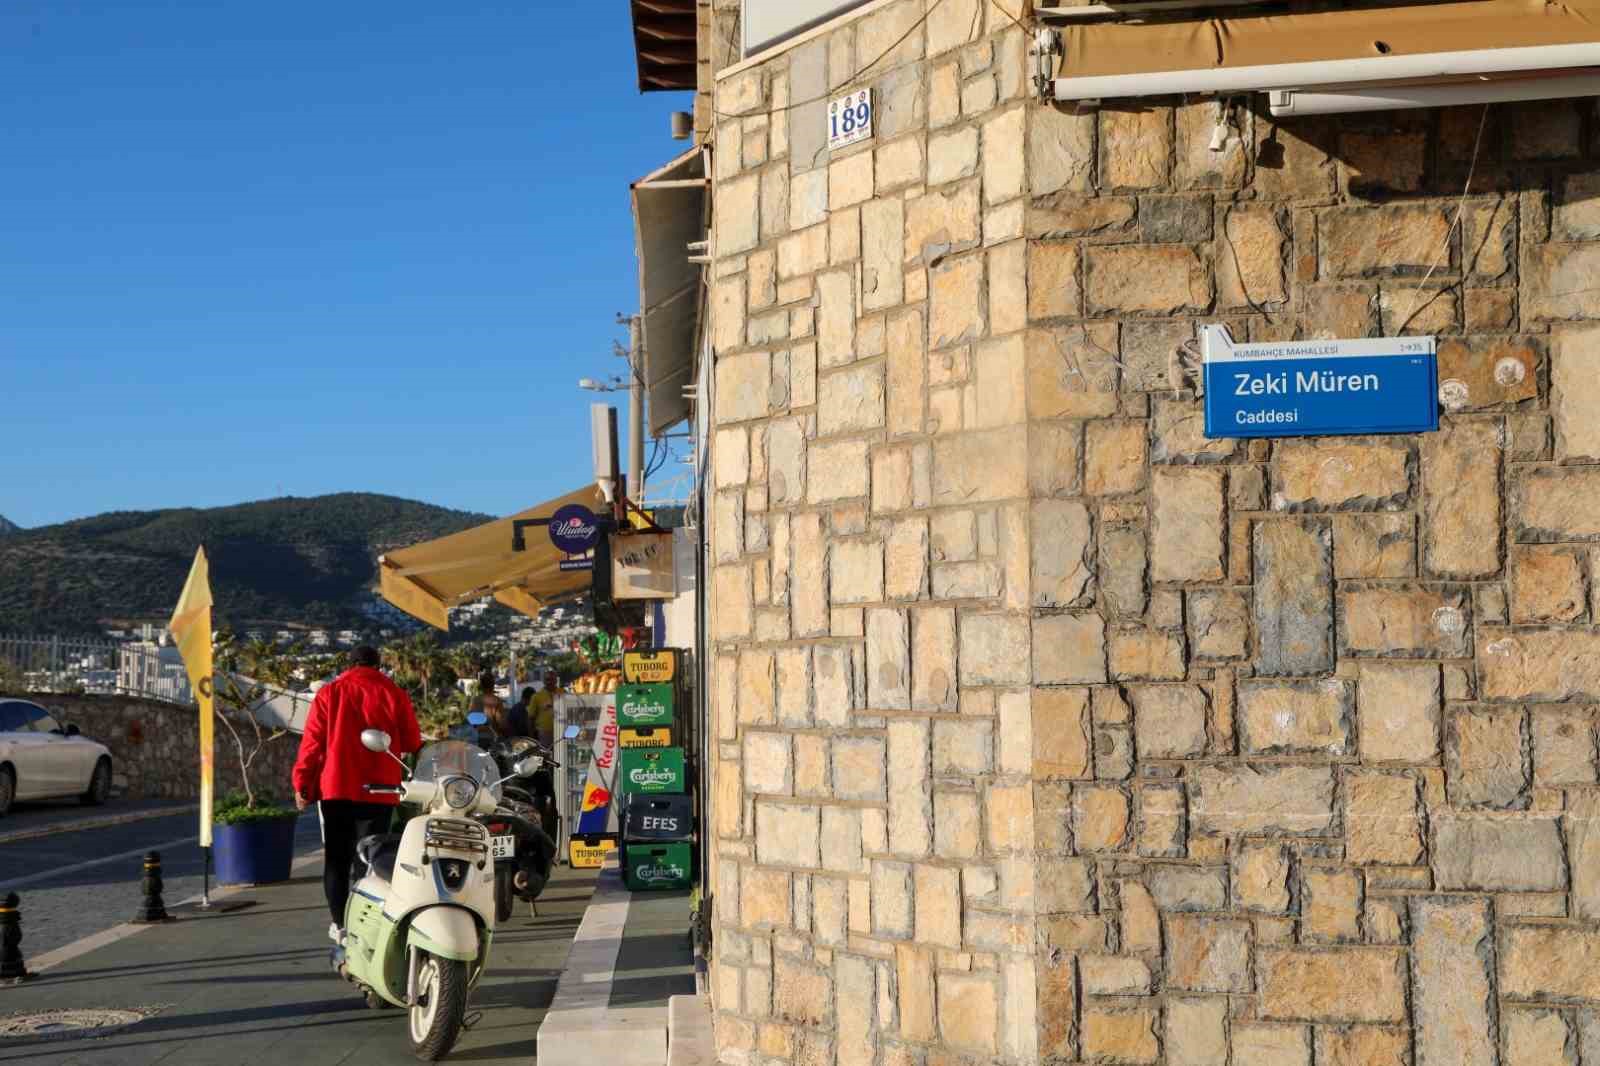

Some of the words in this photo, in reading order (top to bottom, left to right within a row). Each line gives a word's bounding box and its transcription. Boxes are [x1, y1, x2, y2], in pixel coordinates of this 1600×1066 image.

[831, 102, 869, 138] 189
[1233, 347, 1285, 359] KUMBAHÇE
[1233, 371, 1287, 396] Zeki
[1296, 370, 1379, 394] Müren
[1235, 408, 1299, 425] Caddesi
[631, 663, 668, 672] TUBORG
[622, 702, 665, 717] Carlsberg
[630, 768, 676, 785] Carlsberg
[643, 816, 678, 831] EFES
[636, 864, 684, 882] Carlsberg
